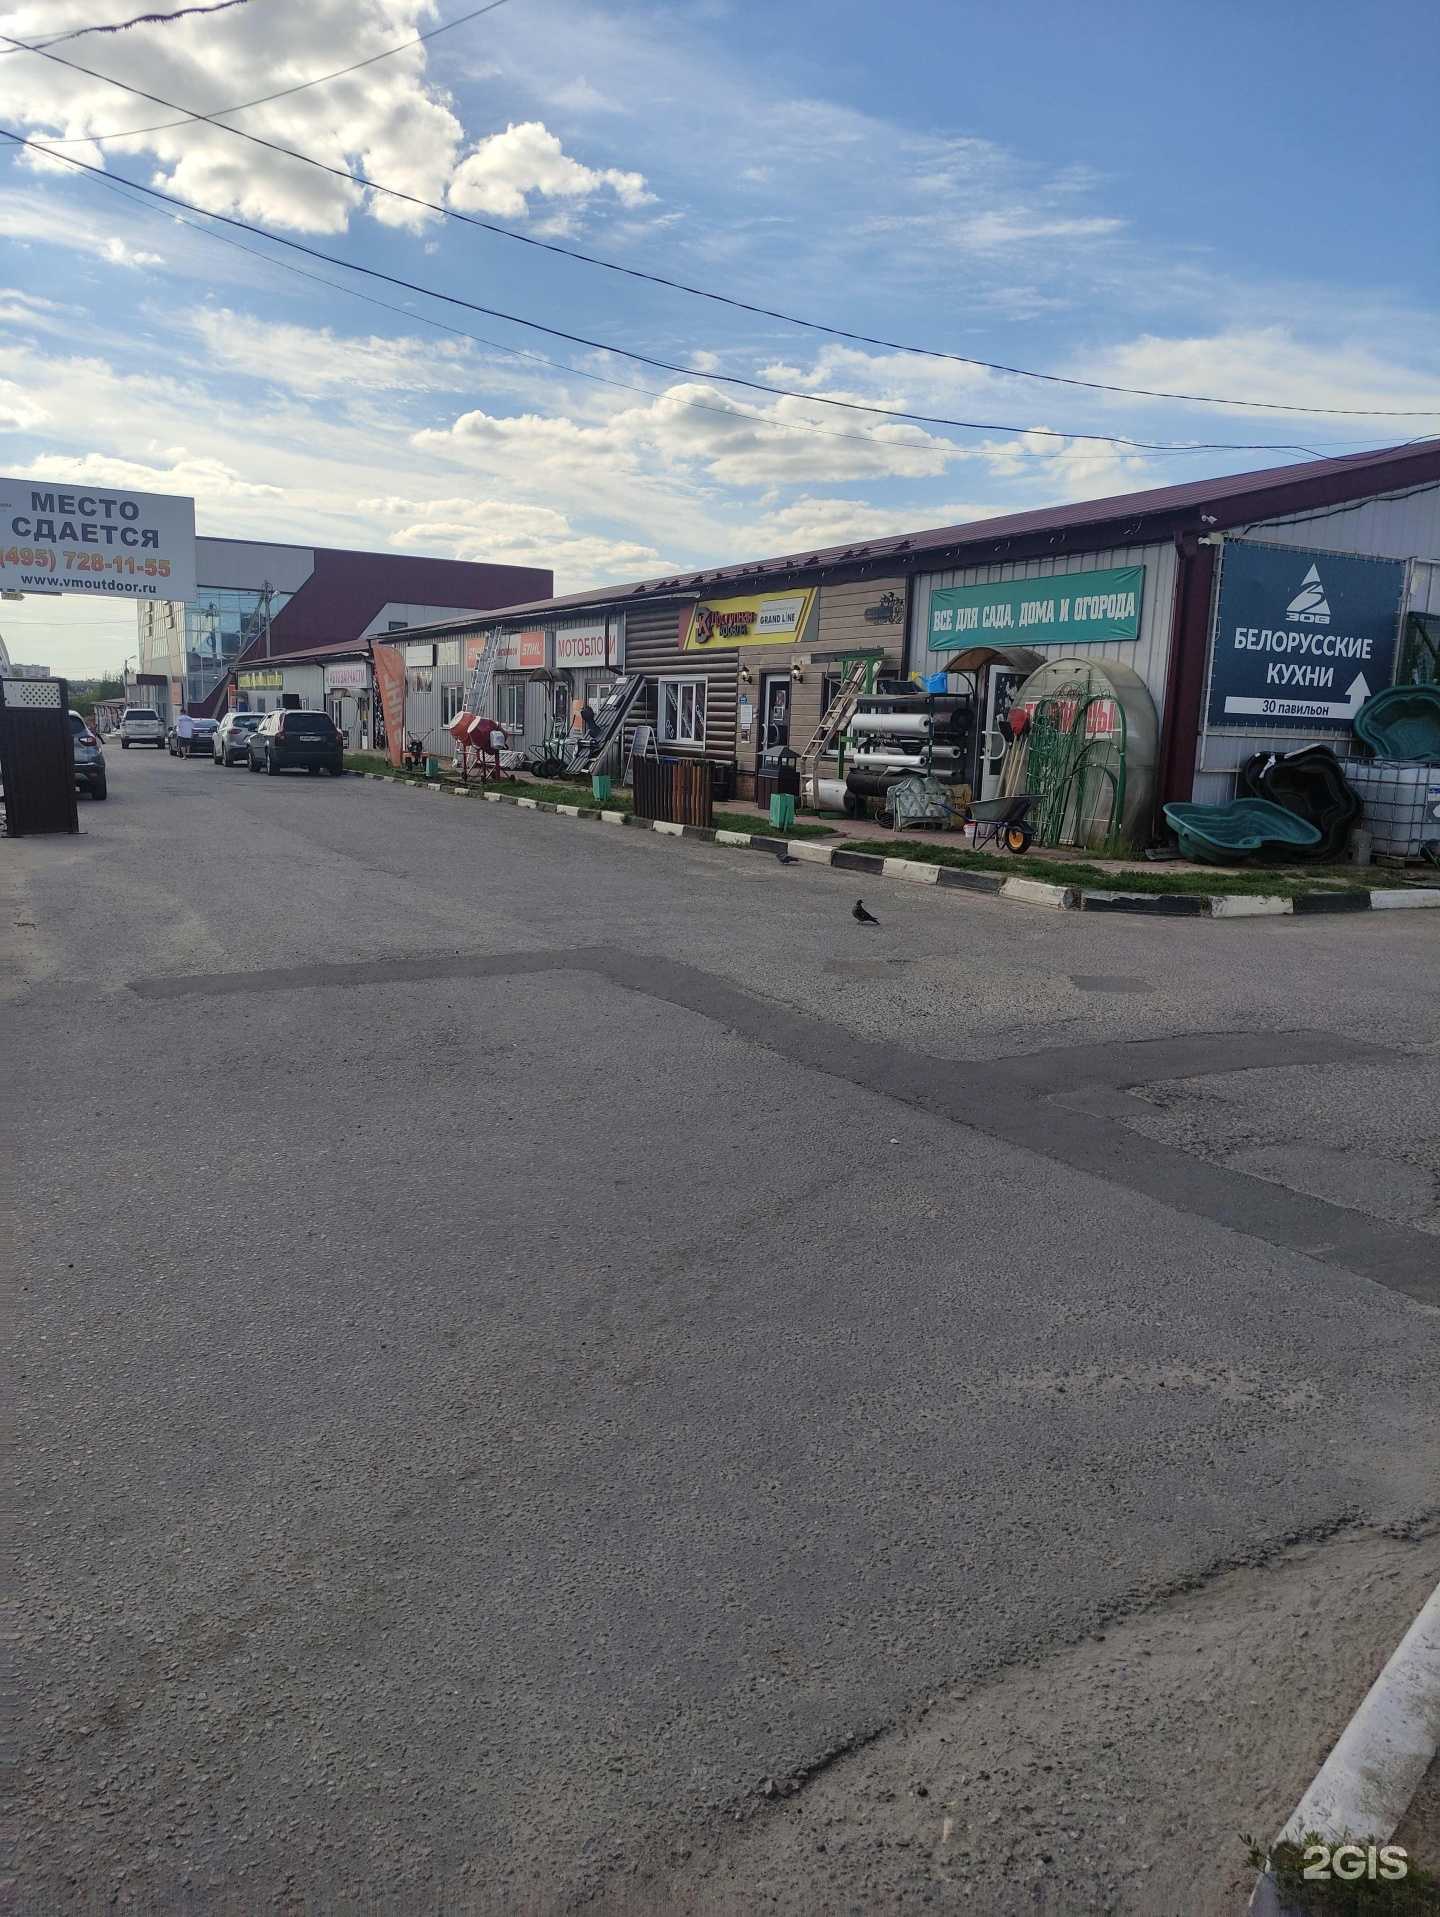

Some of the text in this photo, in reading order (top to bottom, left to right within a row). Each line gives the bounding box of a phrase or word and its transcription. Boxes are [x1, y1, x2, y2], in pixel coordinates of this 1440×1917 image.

[31, 491, 140, 521] МЕСТО
[12, 516, 160, 549] СДАЕТСЯ
[63, 550, 172, 578] 728-11-55
[21, 574, 157, 594] www.vmoutdoor.ru
[760, 614, 781, 625] GRAND
[933, 591, 1135, 632] ВСЕ ДЛЯ САДА, ДОМА И ОГОРОДА
[558, 634, 616, 658] МОТОБЛОИ
[1234, 627, 1374, 660] БЕЛОРУССКИЕ
[1266, 663, 1334, 688] КУХНИ
[1262, 699, 1329, 716] 30 павильон
